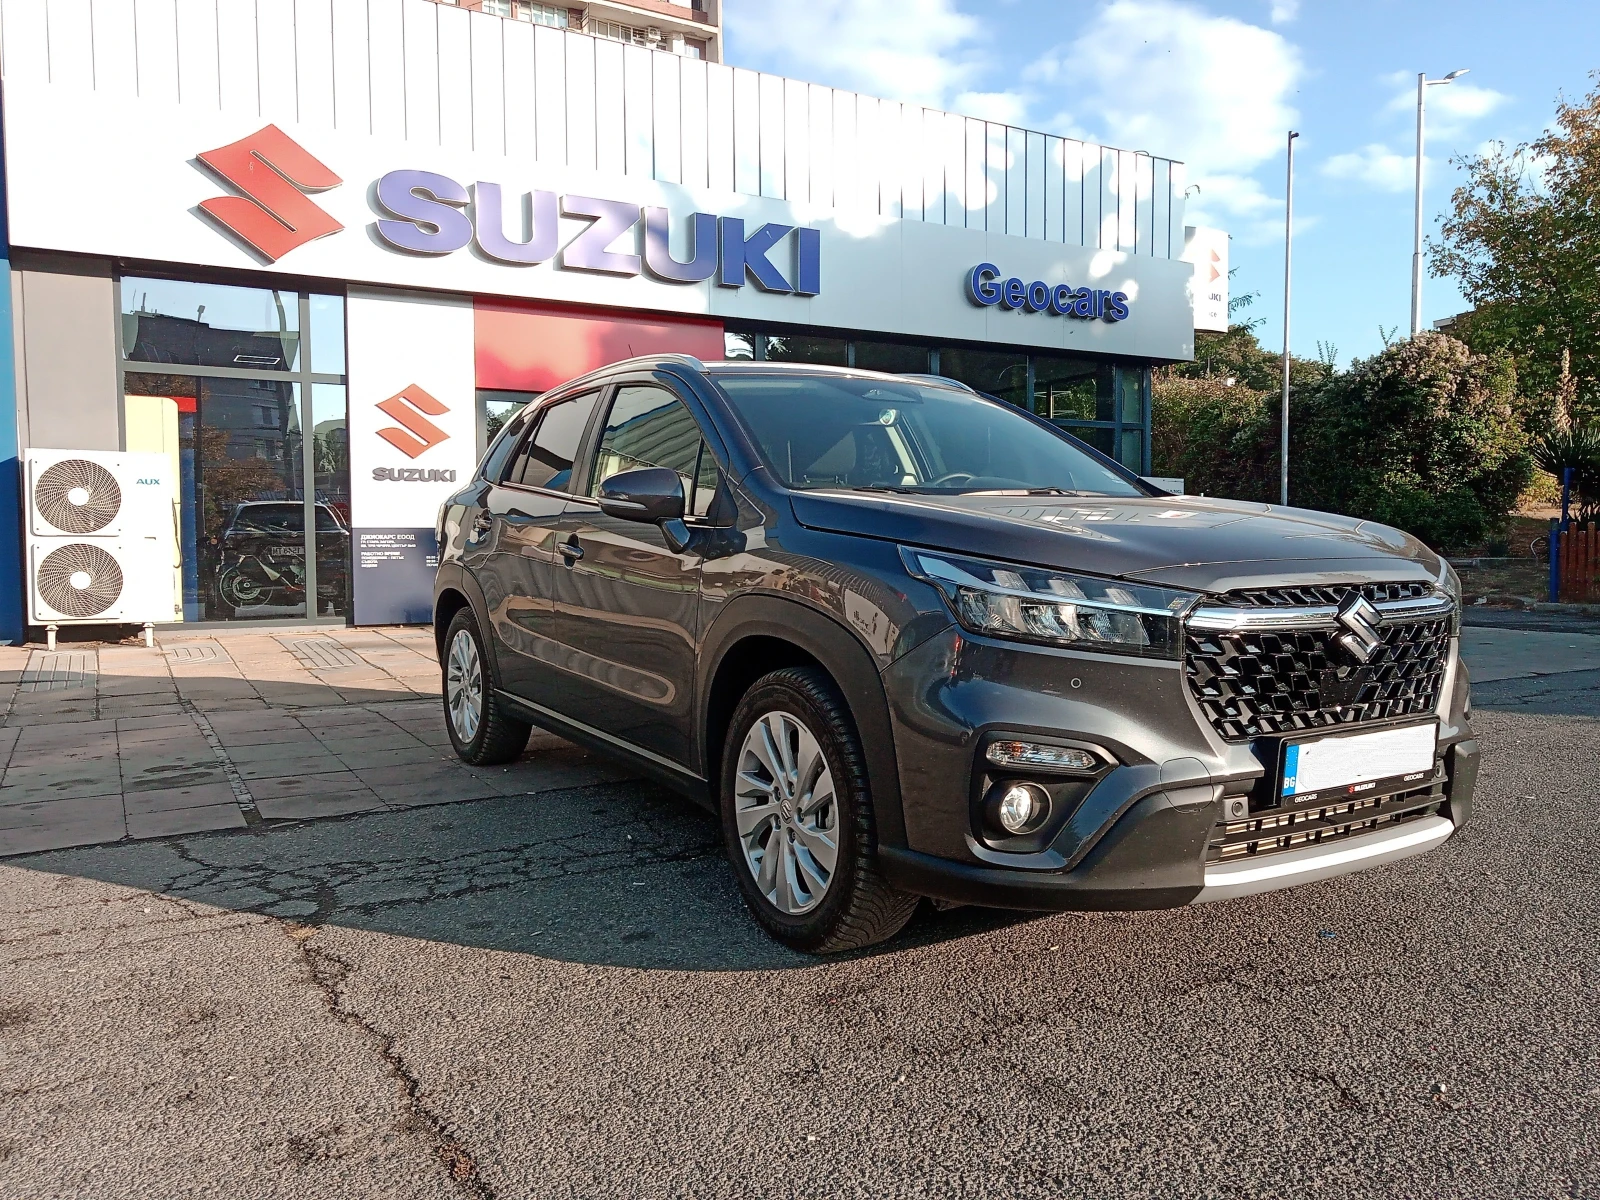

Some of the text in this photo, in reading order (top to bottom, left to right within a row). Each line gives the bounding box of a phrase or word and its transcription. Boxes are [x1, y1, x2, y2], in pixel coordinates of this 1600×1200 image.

[374, 168, 820, 296] SUZUKI
[969, 262, 1129, 322] Geocars
[372, 467, 456, 482] SUZUKI
[1284, 776, 1296, 788] BG
[1404, 773, 1424, 781] GEOCARS
[1294, 793, 1317, 803] GEOCARS
